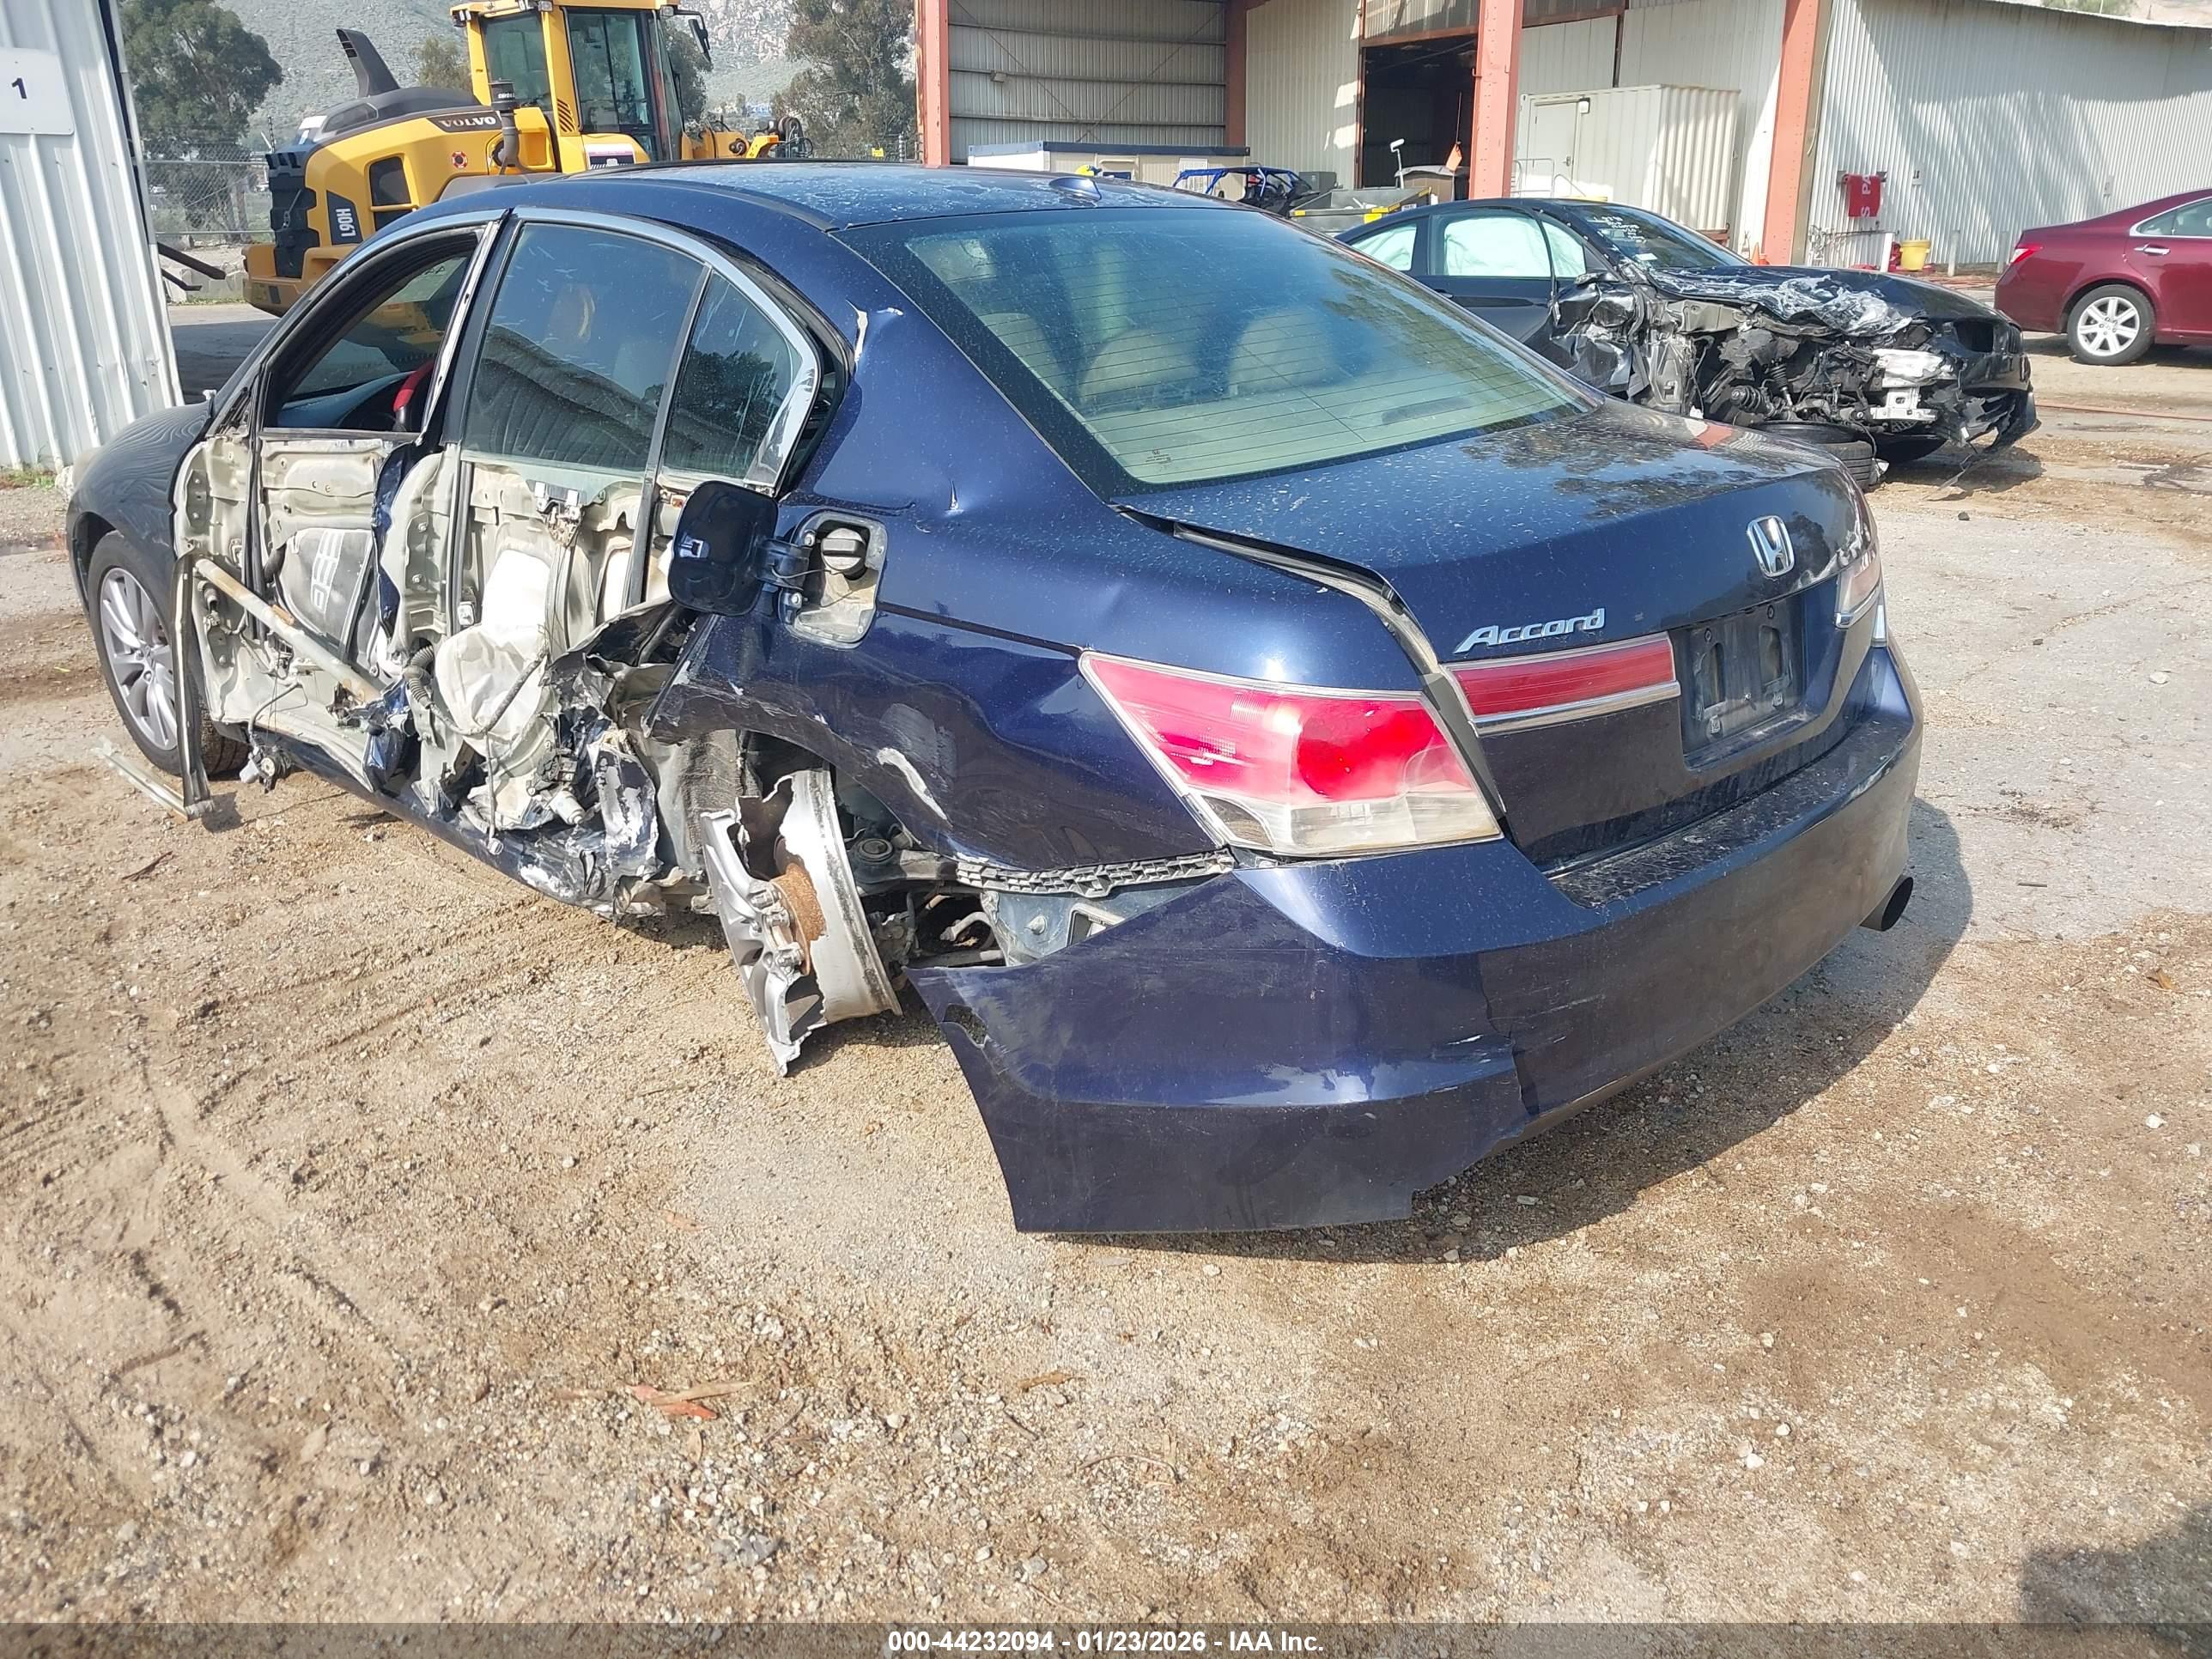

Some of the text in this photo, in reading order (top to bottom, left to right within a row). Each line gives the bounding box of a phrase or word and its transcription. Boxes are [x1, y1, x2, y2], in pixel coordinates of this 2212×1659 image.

[11, 77, 27, 100] 1
[438, 116, 496, 128] VOLVO
[335, 208, 356, 237] L90H
[1452, 607, 1605, 654] Accord
